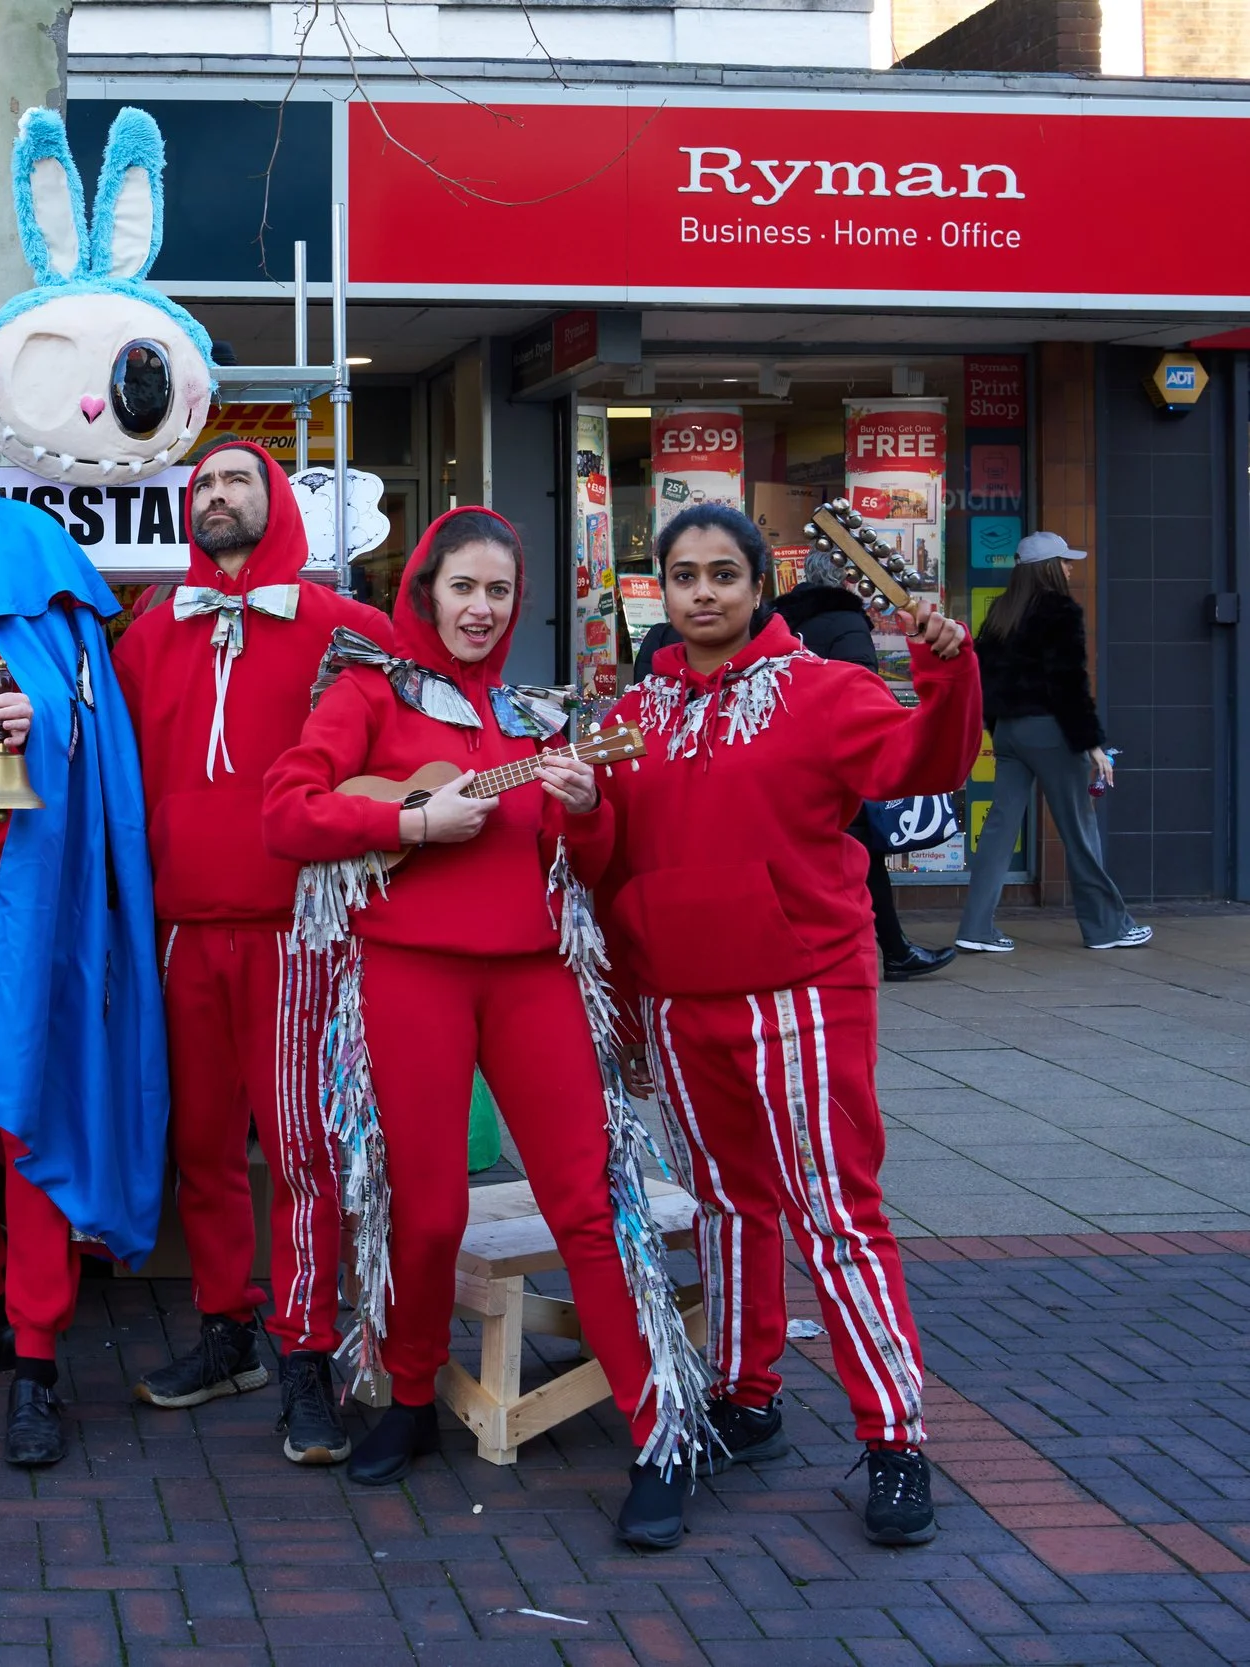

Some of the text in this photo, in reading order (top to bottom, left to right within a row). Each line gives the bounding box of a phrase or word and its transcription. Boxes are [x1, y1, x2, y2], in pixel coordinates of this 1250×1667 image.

[678, 146, 1026, 206] Ryman
[681, 216, 1022, 249] Business Home Office
[970, 362, 1019, 374] Ryman
[1166, 371, 1196, 385] ADT
[970, 379, 1020, 396] Print
[970, 399, 1020, 420] Shop
[860, 424, 932, 434] Buy One, Get One
[661, 428, 738, 453] £9.99
[857, 434, 936, 458] FREE
[666, 481, 684, 494] 251
[861, 496, 878, 509] £6
[758, 513, 767, 526] 6
[984, 554, 1008, 564] COPY
[631, 582, 650, 590] Half
[910, 851, 946, 860] Cartridges
